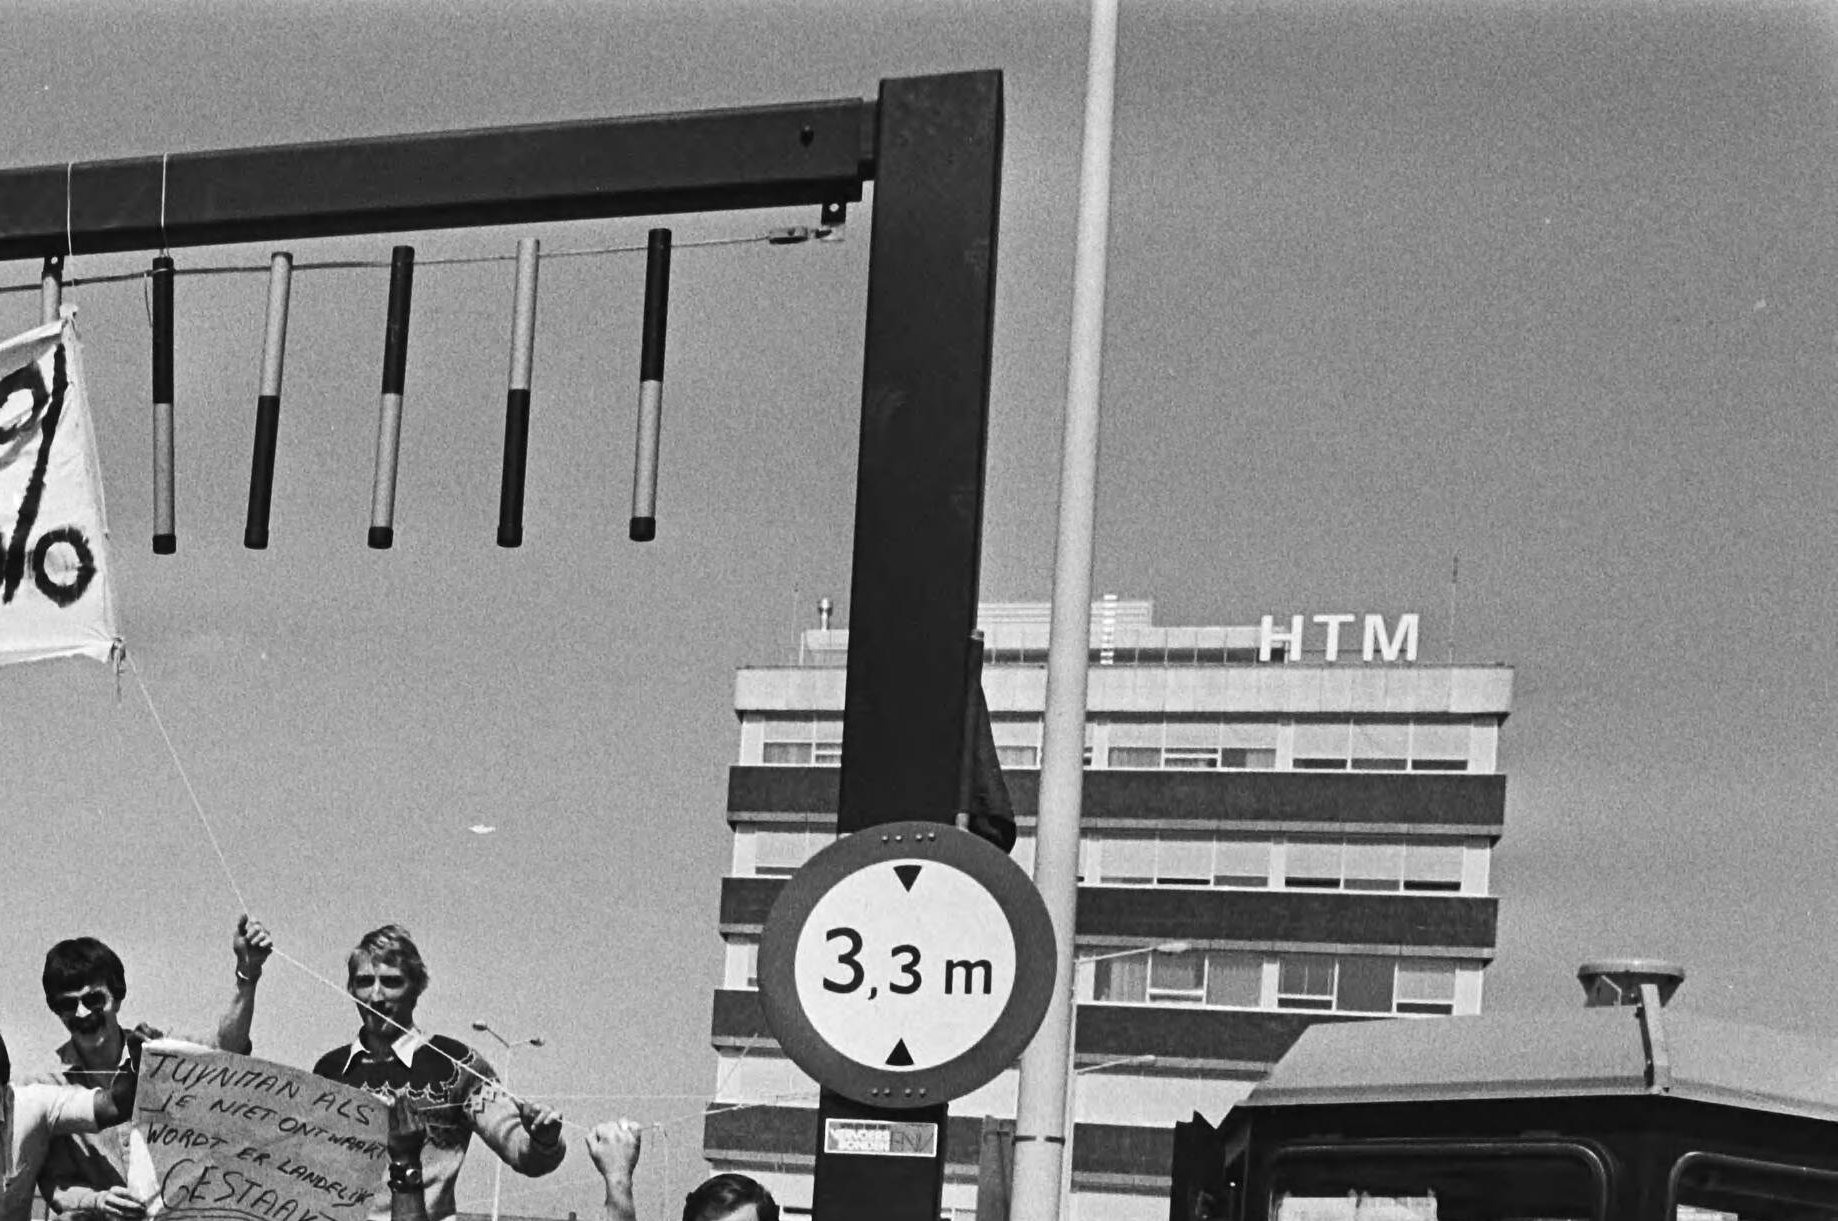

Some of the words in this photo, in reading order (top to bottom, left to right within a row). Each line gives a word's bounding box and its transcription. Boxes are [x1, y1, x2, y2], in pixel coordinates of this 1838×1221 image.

[1258, 613, 1420, 662] HTM
[822, 927, 923, 1001] 3,3
[944, 958, 993, 995] m
[139, 1091, 196, 1113] JE
[210, 1098, 277, 1121] NIET
[148, 1052, 300, 1098] TUYNMAN
[313, 1092, 374, 1126] ALS
[147, 1121, 228, 1149] WORDT
[237, 1147, 271, 1167] ER
